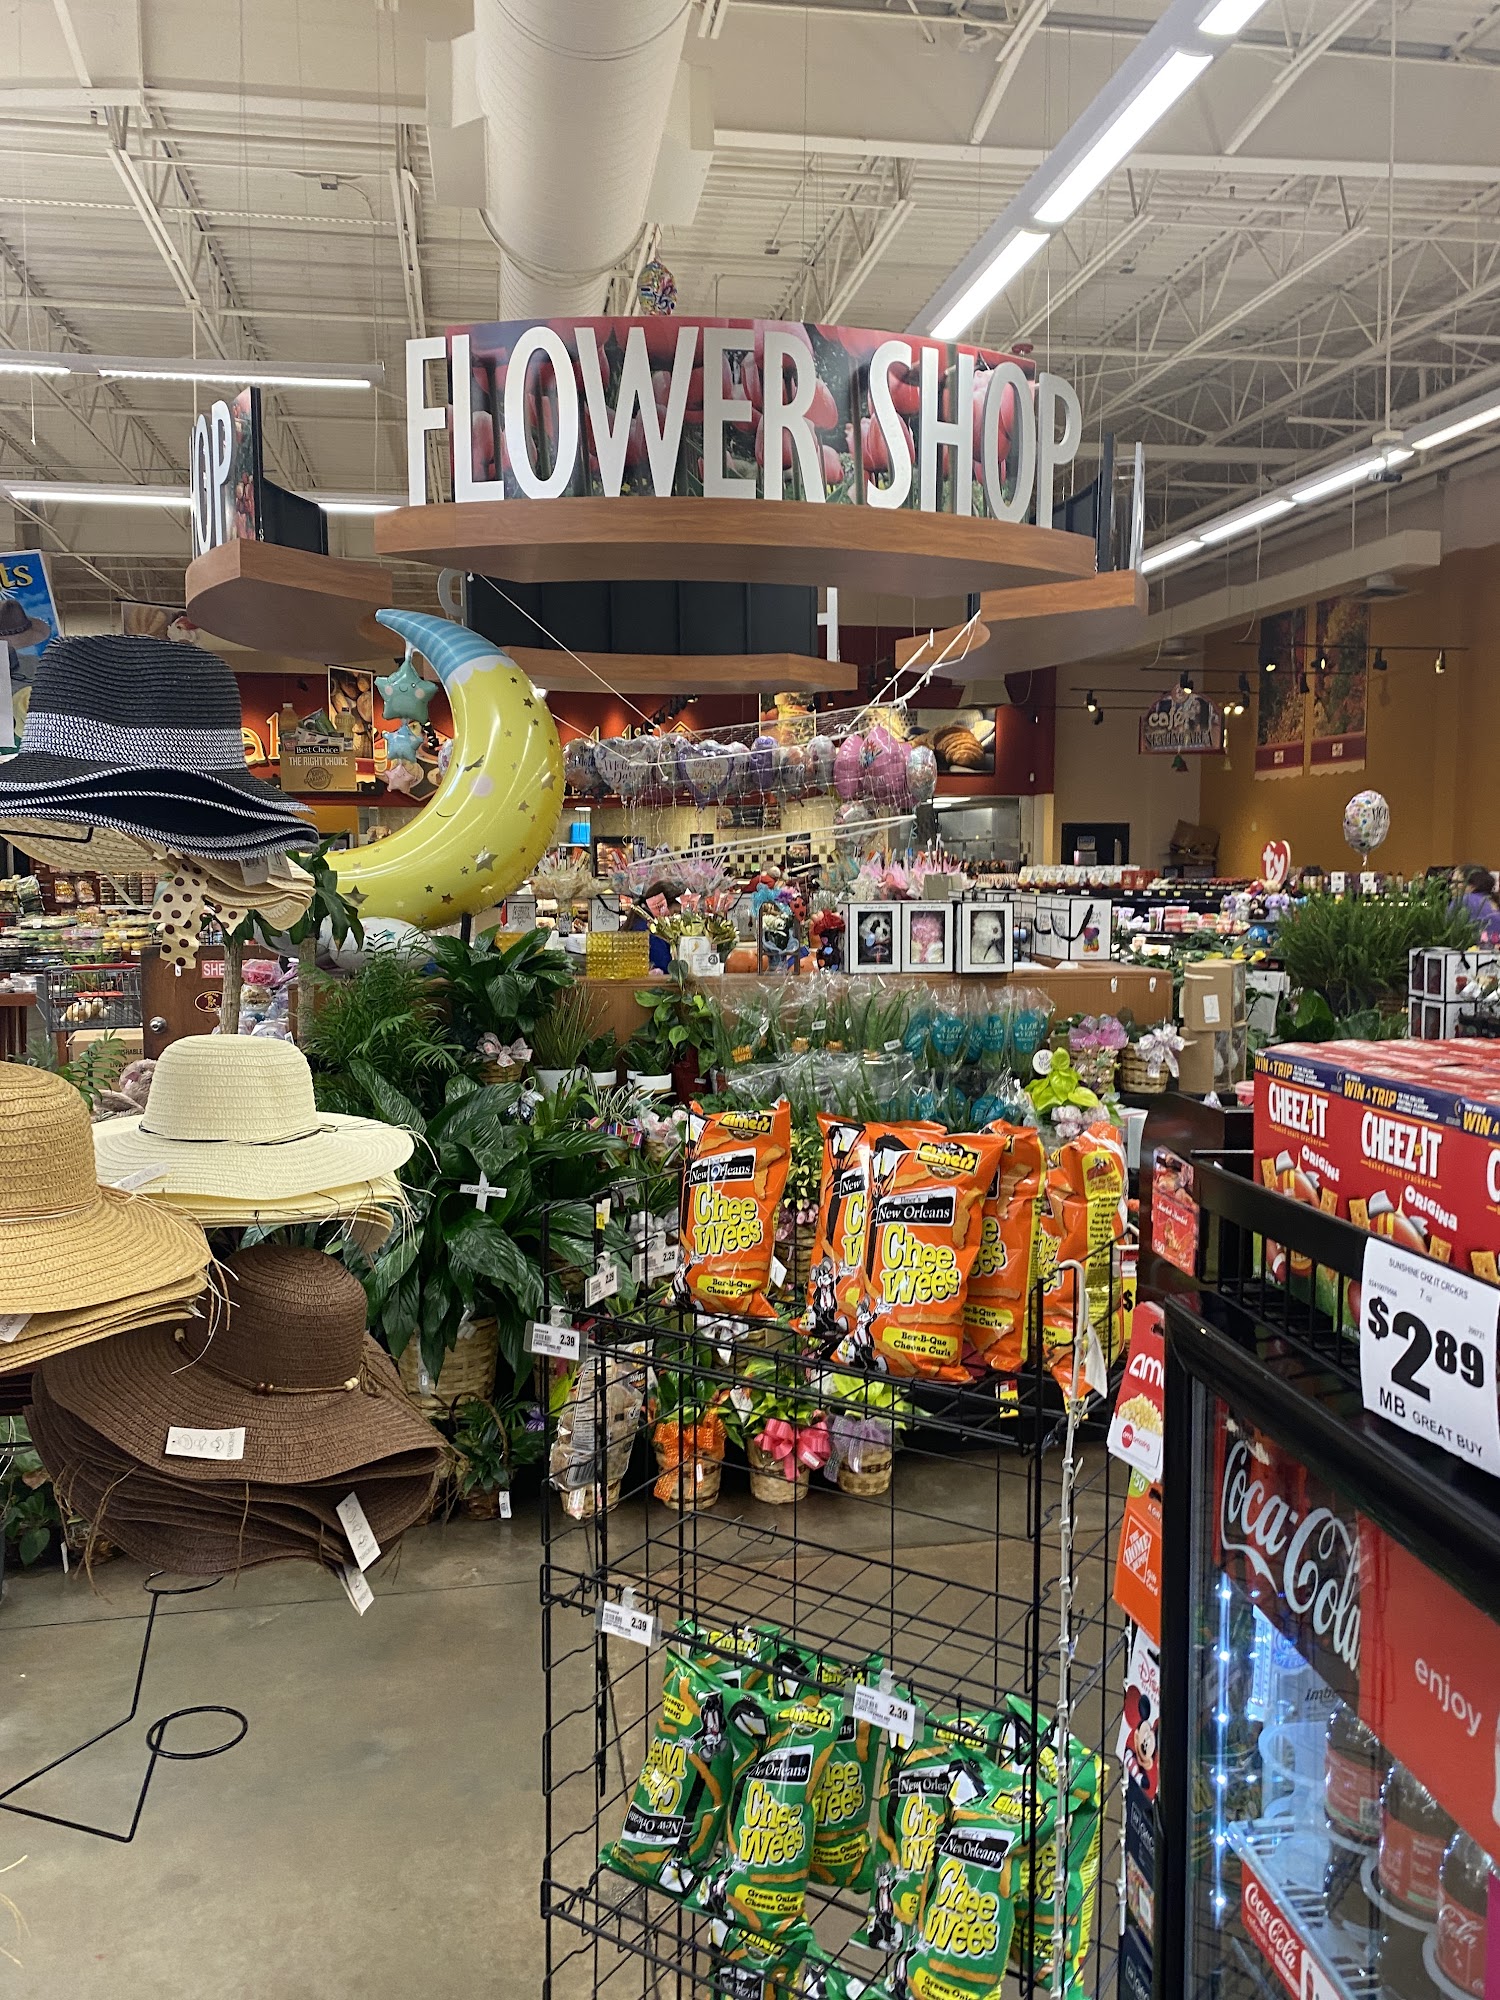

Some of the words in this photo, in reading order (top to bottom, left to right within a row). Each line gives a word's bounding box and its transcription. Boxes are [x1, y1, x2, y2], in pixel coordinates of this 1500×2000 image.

[406, 326, 828, 506] FLOWER
[866, 340, 1082, 529] SHOP
[289, 756, 302, 766] THE
[303, 756, 323, 766] RIGHT
[324, 756, 349, 766] CHOICE
[296, 746, 311, 754] Best
[312, 746, 339, 754] Choice
[1263, 845, 1286, 884] ty
[1255, 1055, 1268, 1074] WIN
[1273, 1061, 1293, 1080] TRIP
[1344, 1080, 1365, 1100] WIN
[1372, 1086, 1397, 1107] TRIP
[720, 1112, 770, 1132] Elmer's
[1463, 1111, 1492, 1137] WIN
[918, 1141, 976, 1171] Elmer's
[691, 1169, 708, 1183] New
[711, 1163, 751, 1180] Orleans
[842, 1178, 862, 1195] New
[695, 1184, 757, 1225] Chee
[878, 1206, 902, 1219] New
[903, 1205, 951, 1219] Orleans
[694, 1222, 762, 1255] Wees
[883, 1224, 954, 1274] Chee
[662, 1250, 676, 1262] 2.29
[882, 1268, 960, 1304] Wees
[1388, 1257, 1420, 1280] SUNSHINE
[1419, 1271, 1434, 1288] CHZ
[1434, 1276, 1441, 1289] IT
[1440, 1279, 1469, 1300] CRCKRS
[1123, 1290, 1134, 1313] $
[559, 1334, 575, 1347] 2.39
[893, 1340, 925, 1354] Cheese
[901, 1331, 948, 1347] Bar-B-Que
[1379, 1387, 1407, 1419] MB
[1411, 1409, 1453, 1442] GREAT
[1456, 1433, 1483, 1458] BUY
[1124, 1532, 1150, 1565] HOME
[1220, 1439, 1360, 1671] Coca-Cola
[1131, 1552, 1148, 1572] DEPOT
[631, 1616, 647, 1632] 2.39
[1414, 1657, 1482, 1737] enjoy
[780, 1706, 830, 1726] Elmer's
[888, 1704, 909, 1721] 2.39
[764, 1763, 807, 1778] Orleans
[900, 1779, 920, 1792] New
[746, 1781, 801, 1835] Chee
[628, 1810, 657, 1833] Orleans
[659, 1820, 681, 1834] New
[740, 1826, 805, 1866] Wees
[963, 1841, 1005, 1863] Orleans
[747, 1888, 774, 1901] Green
[936, 1857, 998, 1923] Chee
[744, 1898, 776, 1911] Cheese
[924, 1907, 998, 1955] Wees
[1244, 1881, 1299, 1970] Coca-Cola
[924, 1975, 951, 1994] Green
